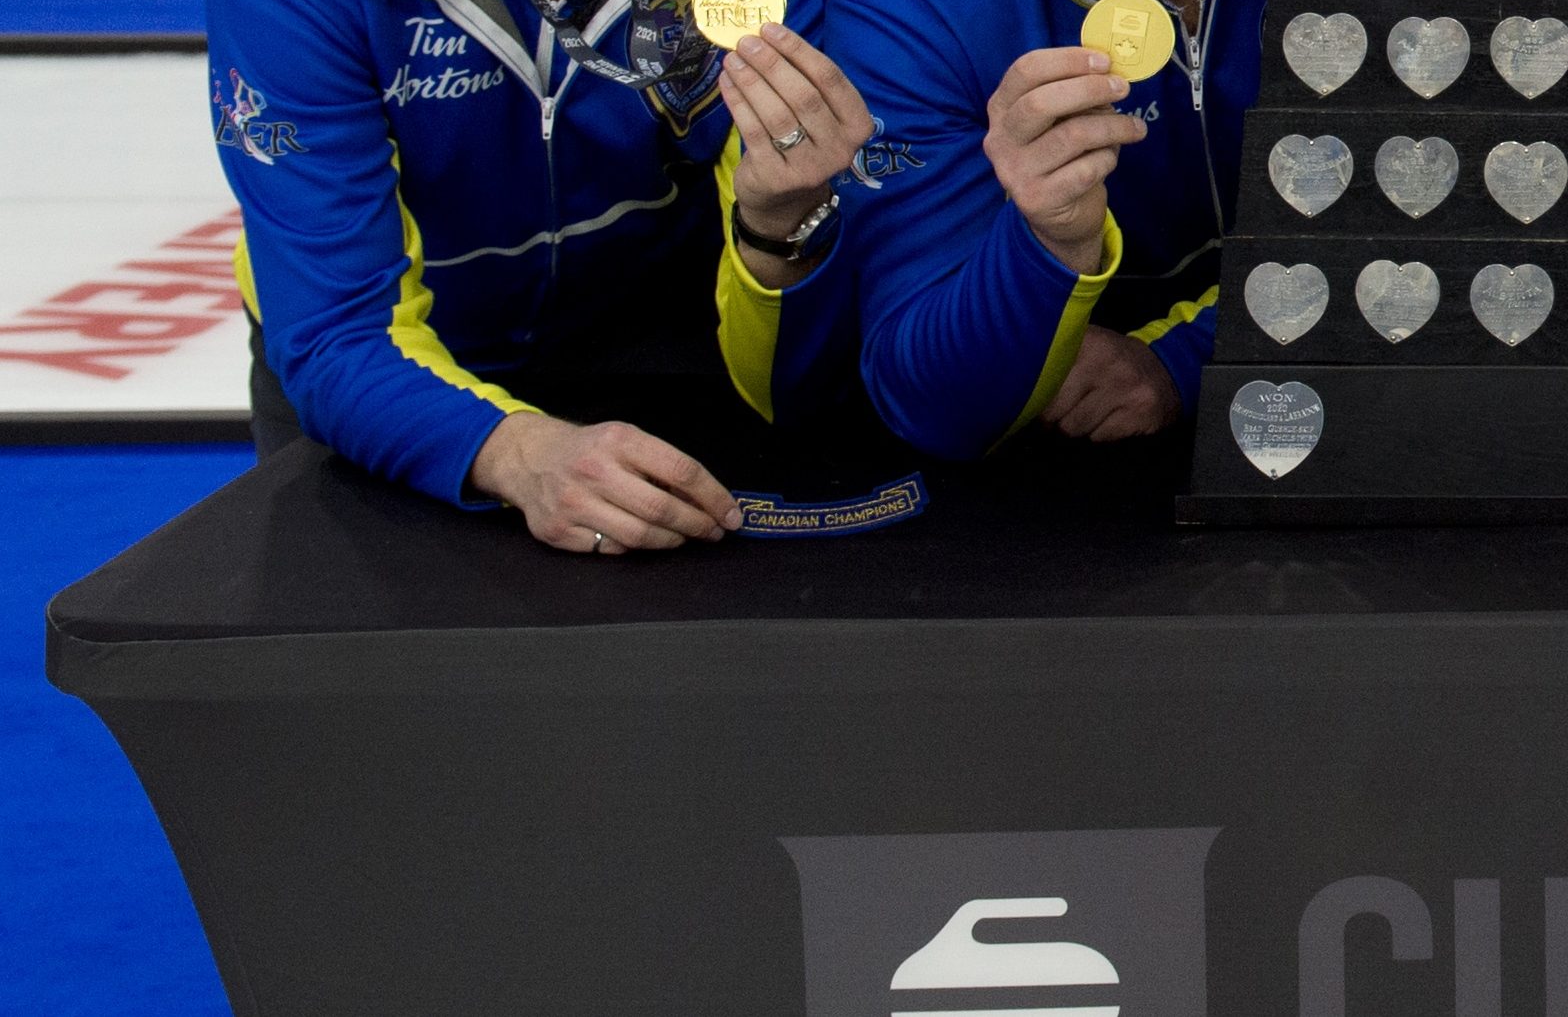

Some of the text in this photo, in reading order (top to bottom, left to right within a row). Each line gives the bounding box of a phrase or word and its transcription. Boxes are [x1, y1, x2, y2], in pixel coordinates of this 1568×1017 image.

[705, 7, 773, 29] BRIER
[404, 16, 468, 58] Tim
[635, 25, 658, 43] 2021
[383, 64, 507, 108] Hortons
[1266, 403, 1289, 413] 2020
[748, 497, 907, 528] CANADIAN CHAMPIONS
